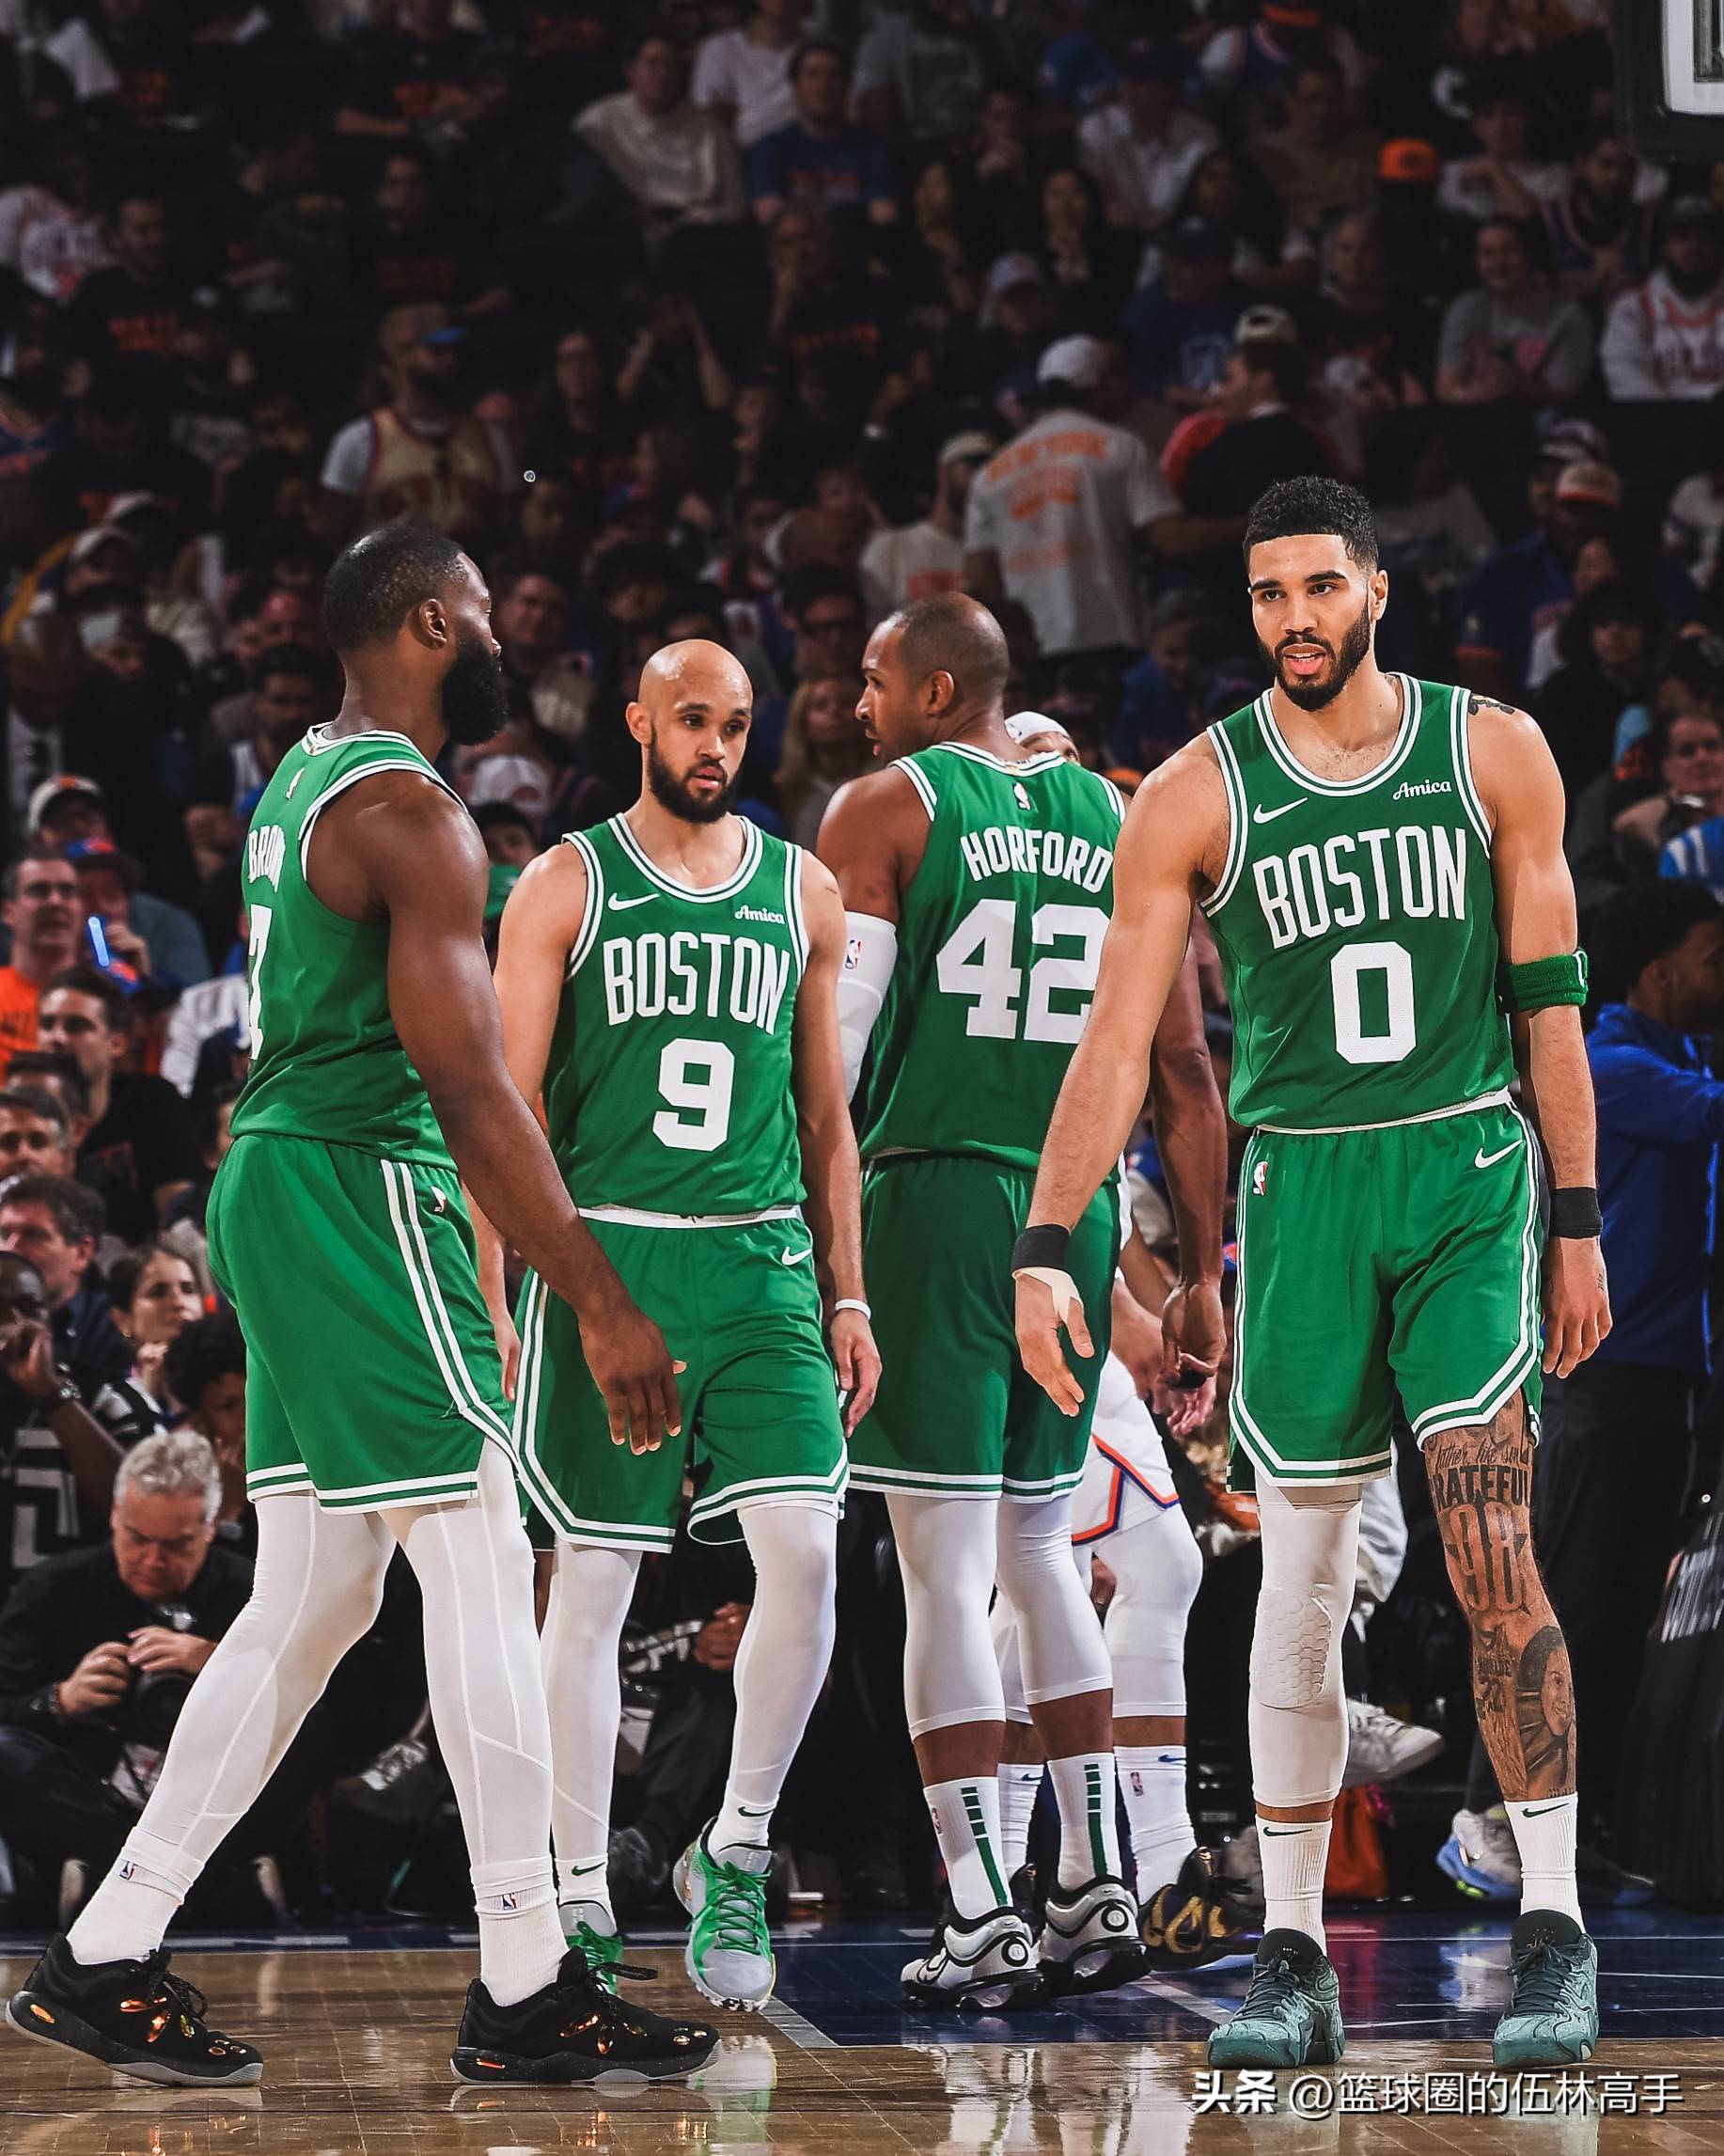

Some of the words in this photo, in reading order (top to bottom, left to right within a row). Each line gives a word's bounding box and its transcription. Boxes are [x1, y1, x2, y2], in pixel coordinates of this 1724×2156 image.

[1392, 779, 1452, 800] Amica
[960, 825, 1114, 893] HORFORD
[1252, 825, 1466, 950] BOSTON
[734, 905, 786, 925] Amica
[603, 931, 791, 1035] BOSTON
[936, 899, 1110, 1045] 42
[1330, 941, 1417, 1064] 0
[652, 1038, 735, 1152] 9
